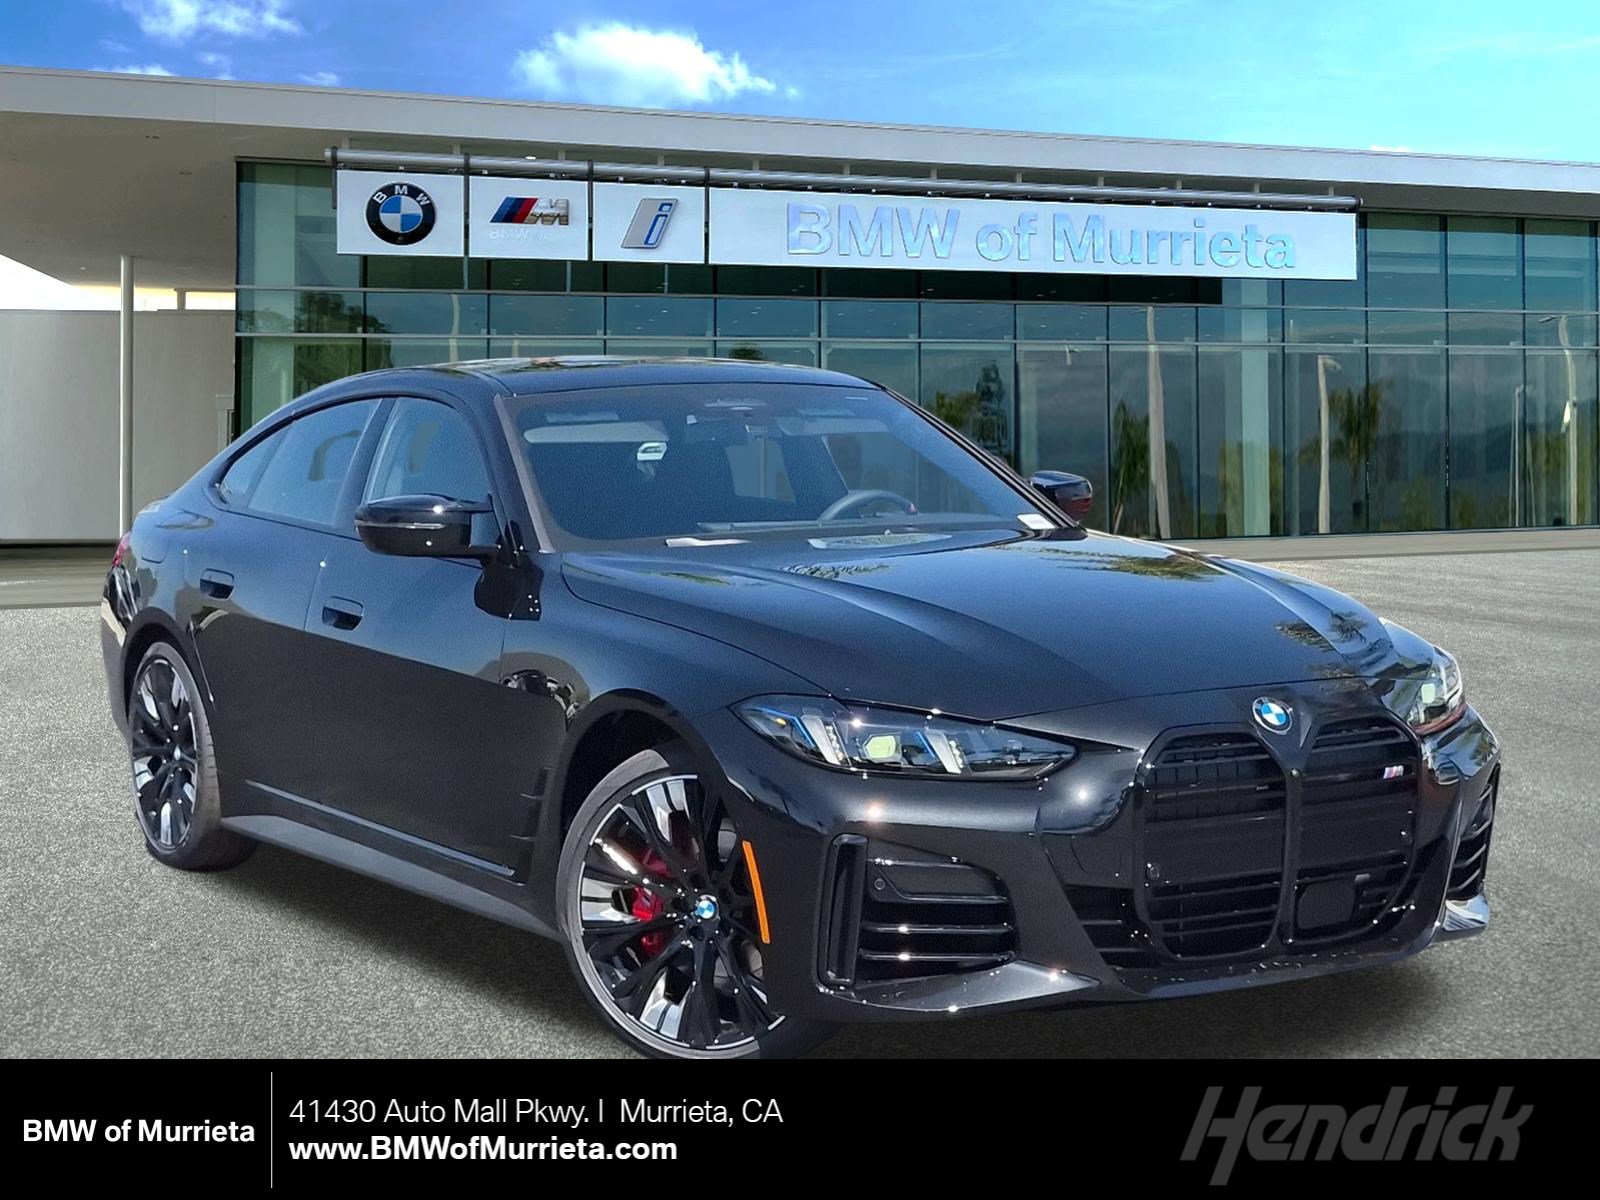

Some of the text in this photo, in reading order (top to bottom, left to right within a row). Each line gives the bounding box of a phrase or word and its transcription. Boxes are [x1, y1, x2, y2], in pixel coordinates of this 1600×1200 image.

[372, 184, 431, 206] BMW
[786, 202, 1297, 270] BMW of Murrieta
